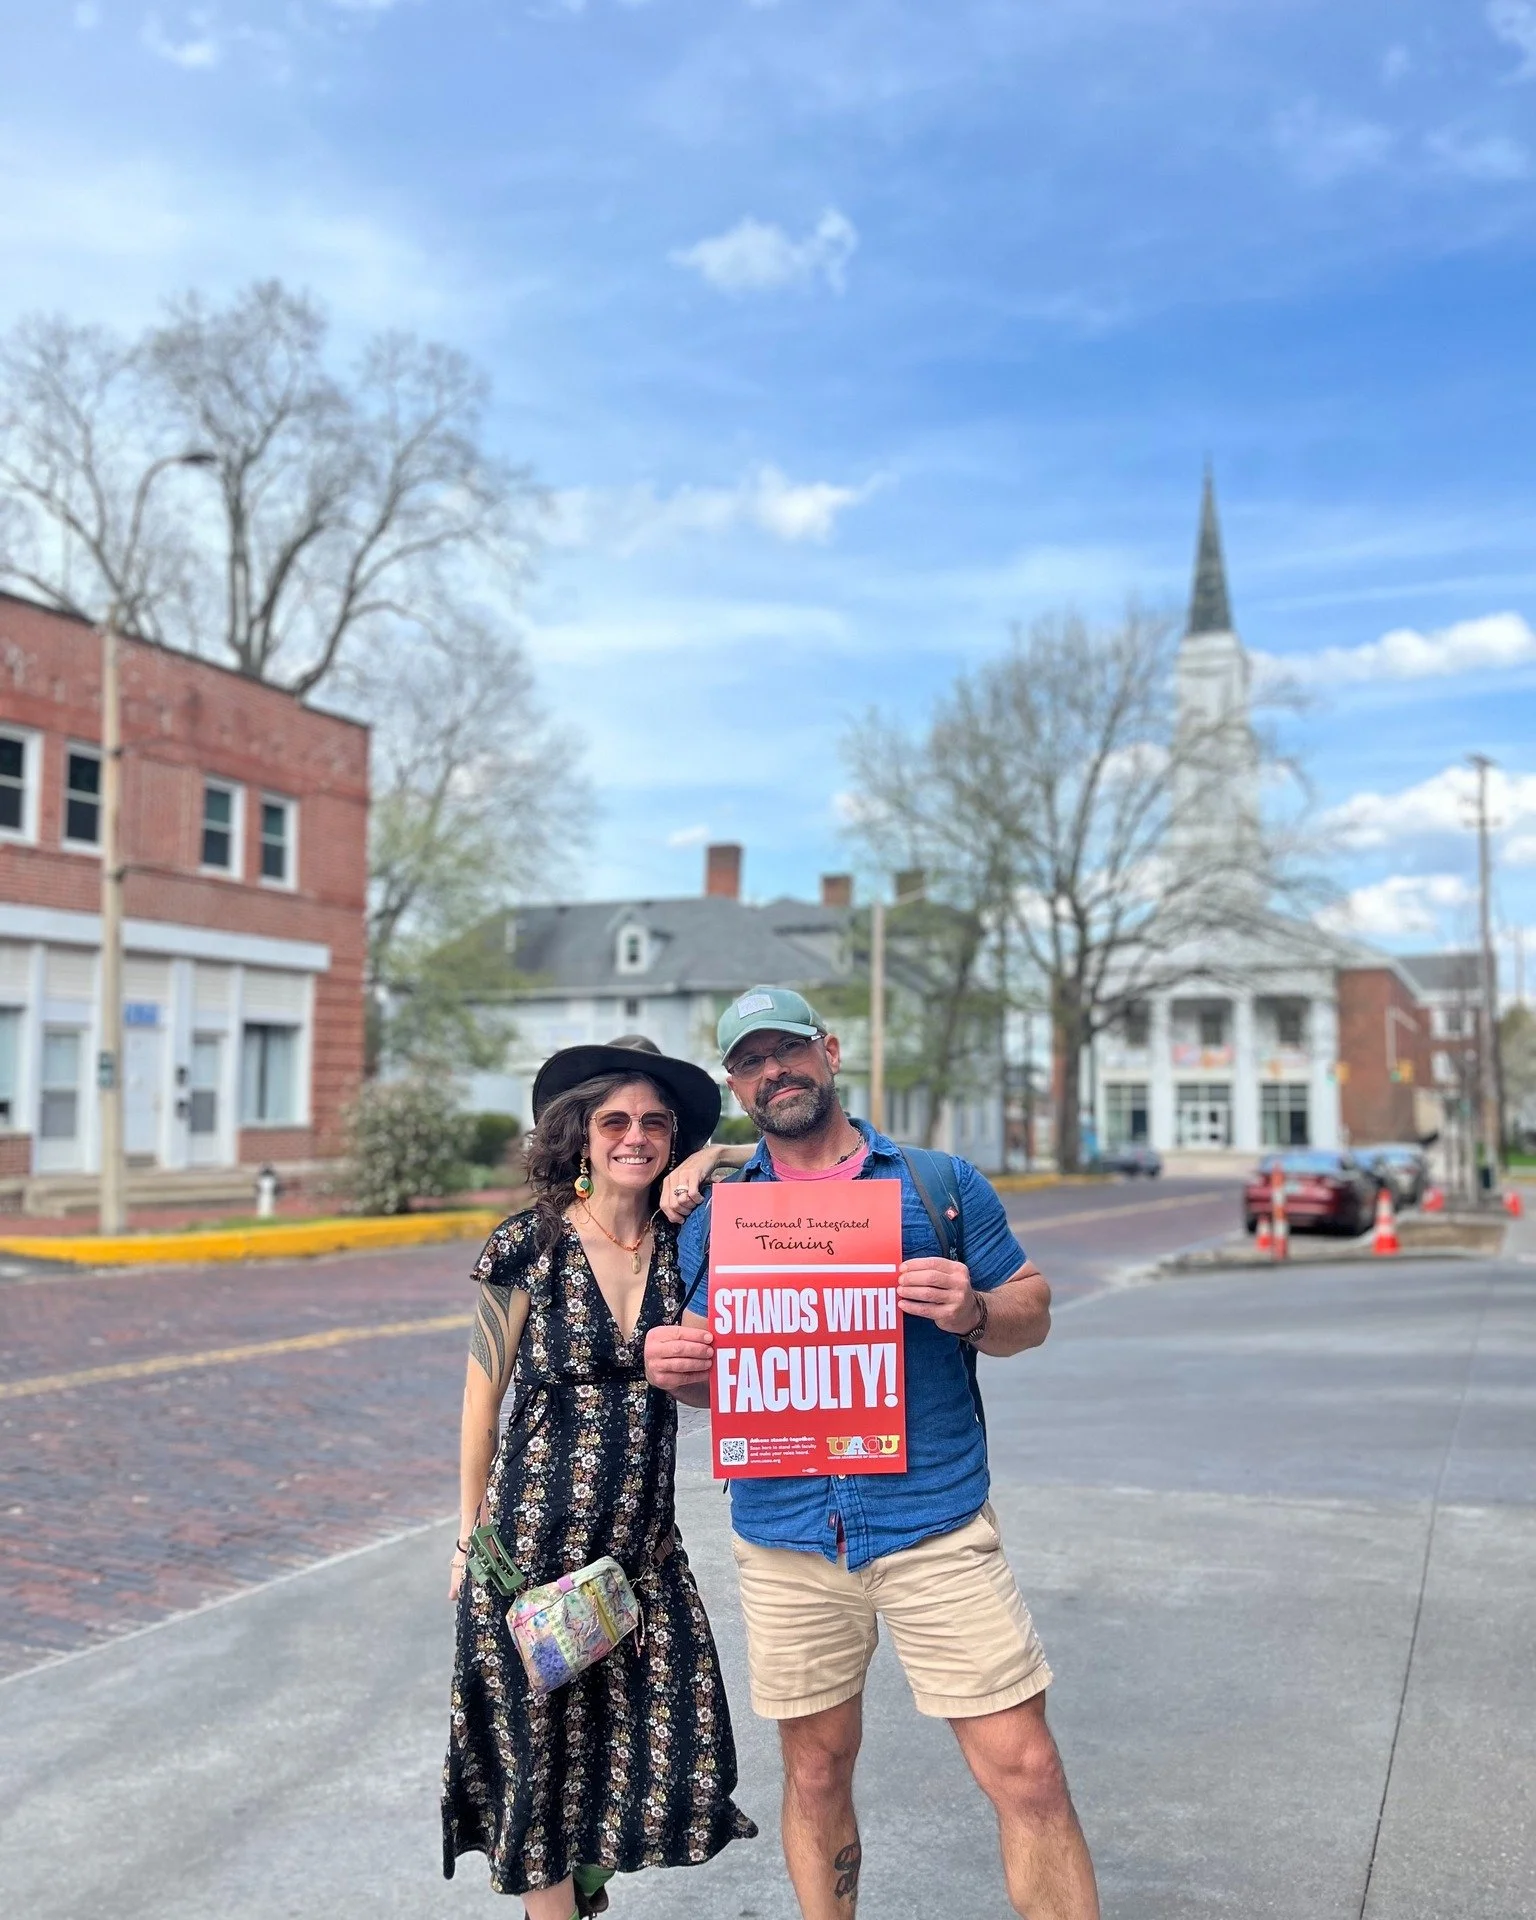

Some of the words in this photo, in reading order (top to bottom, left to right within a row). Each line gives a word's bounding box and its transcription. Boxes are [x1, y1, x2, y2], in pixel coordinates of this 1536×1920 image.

[735, 1217, 802, 1230] Functional
[806, 1218, 870, 1232] Integrated
[755, 1234, 835, 1256] Training
[714, 1287, 819, 1335] STANDS
[822, 1287, 897, 1333] WITH
[716, 1342, 899, 1414] FACULTY!
